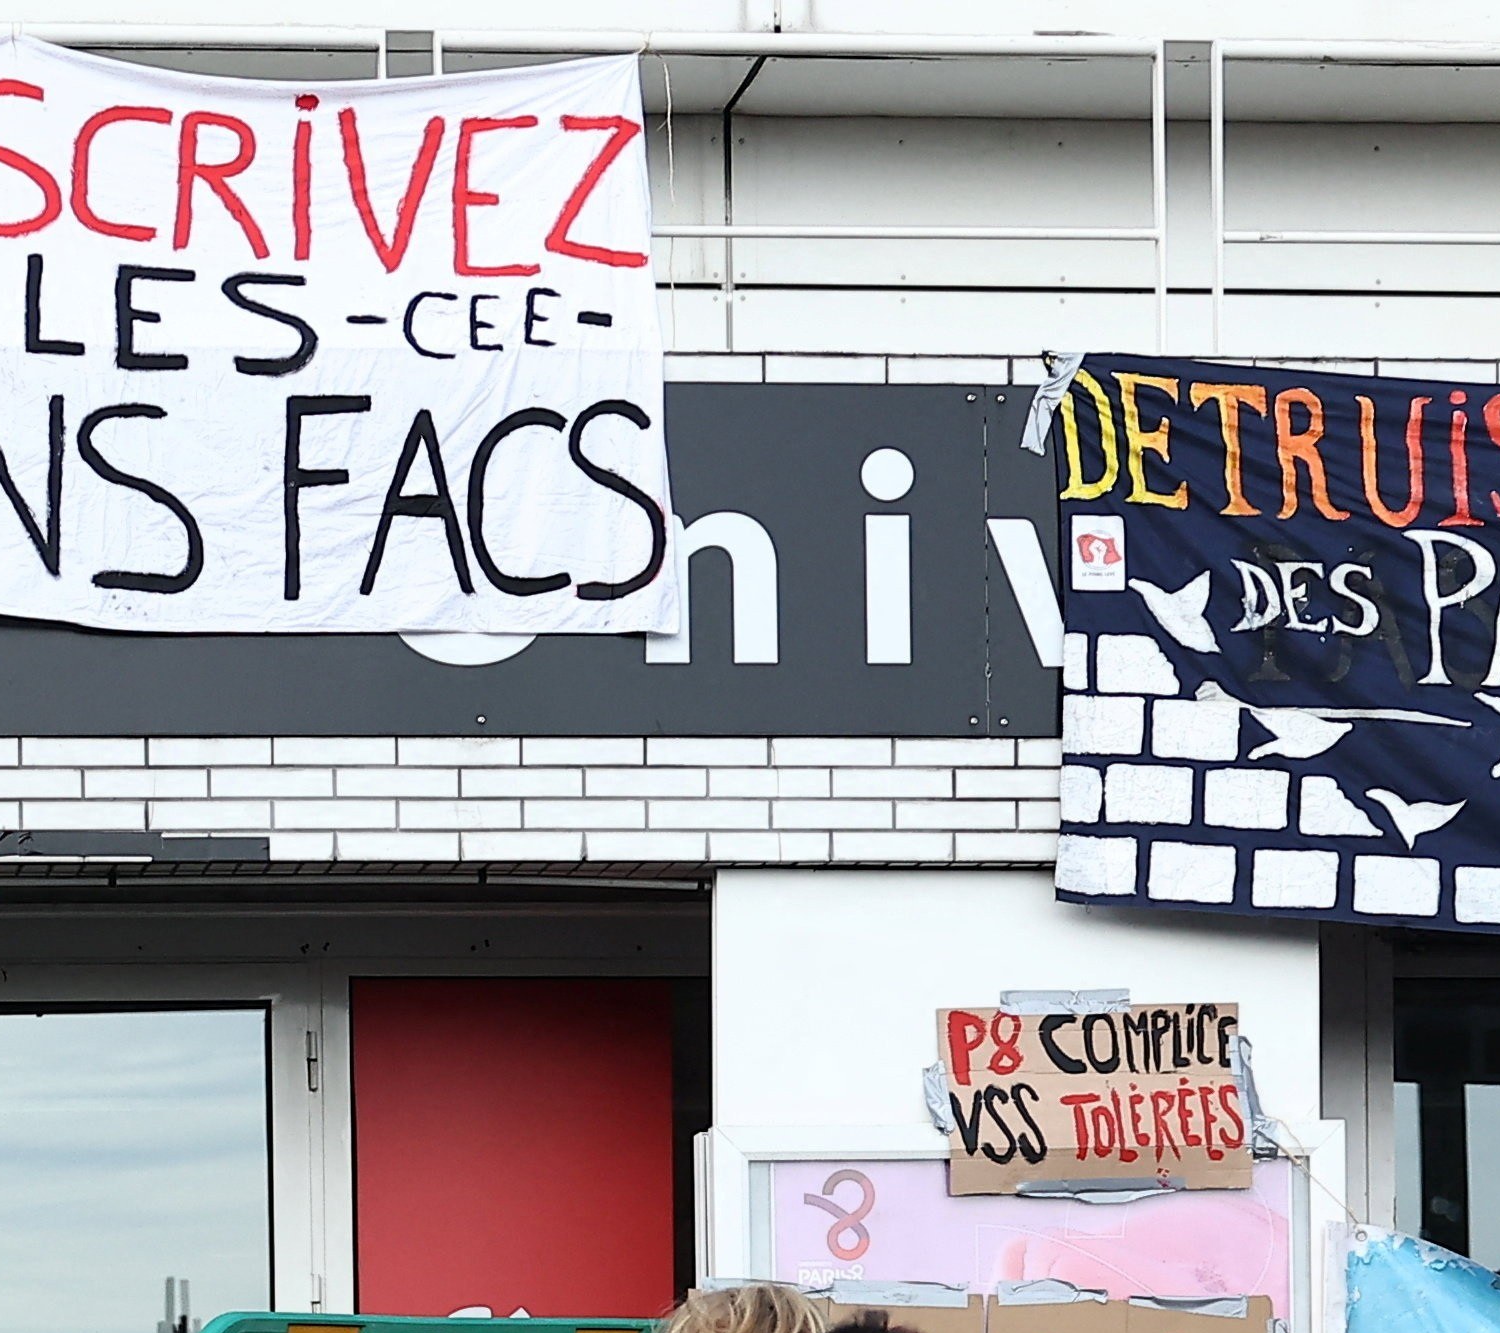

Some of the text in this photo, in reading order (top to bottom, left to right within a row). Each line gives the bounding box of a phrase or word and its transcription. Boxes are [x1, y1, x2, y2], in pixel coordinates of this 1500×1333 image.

[284, 394, 666, 602] FACS
[1230, 558, 1380, 637] DES
[947, 1010, 1024, 1086] P8
[950, 1082, 1048, 1165] VSS
